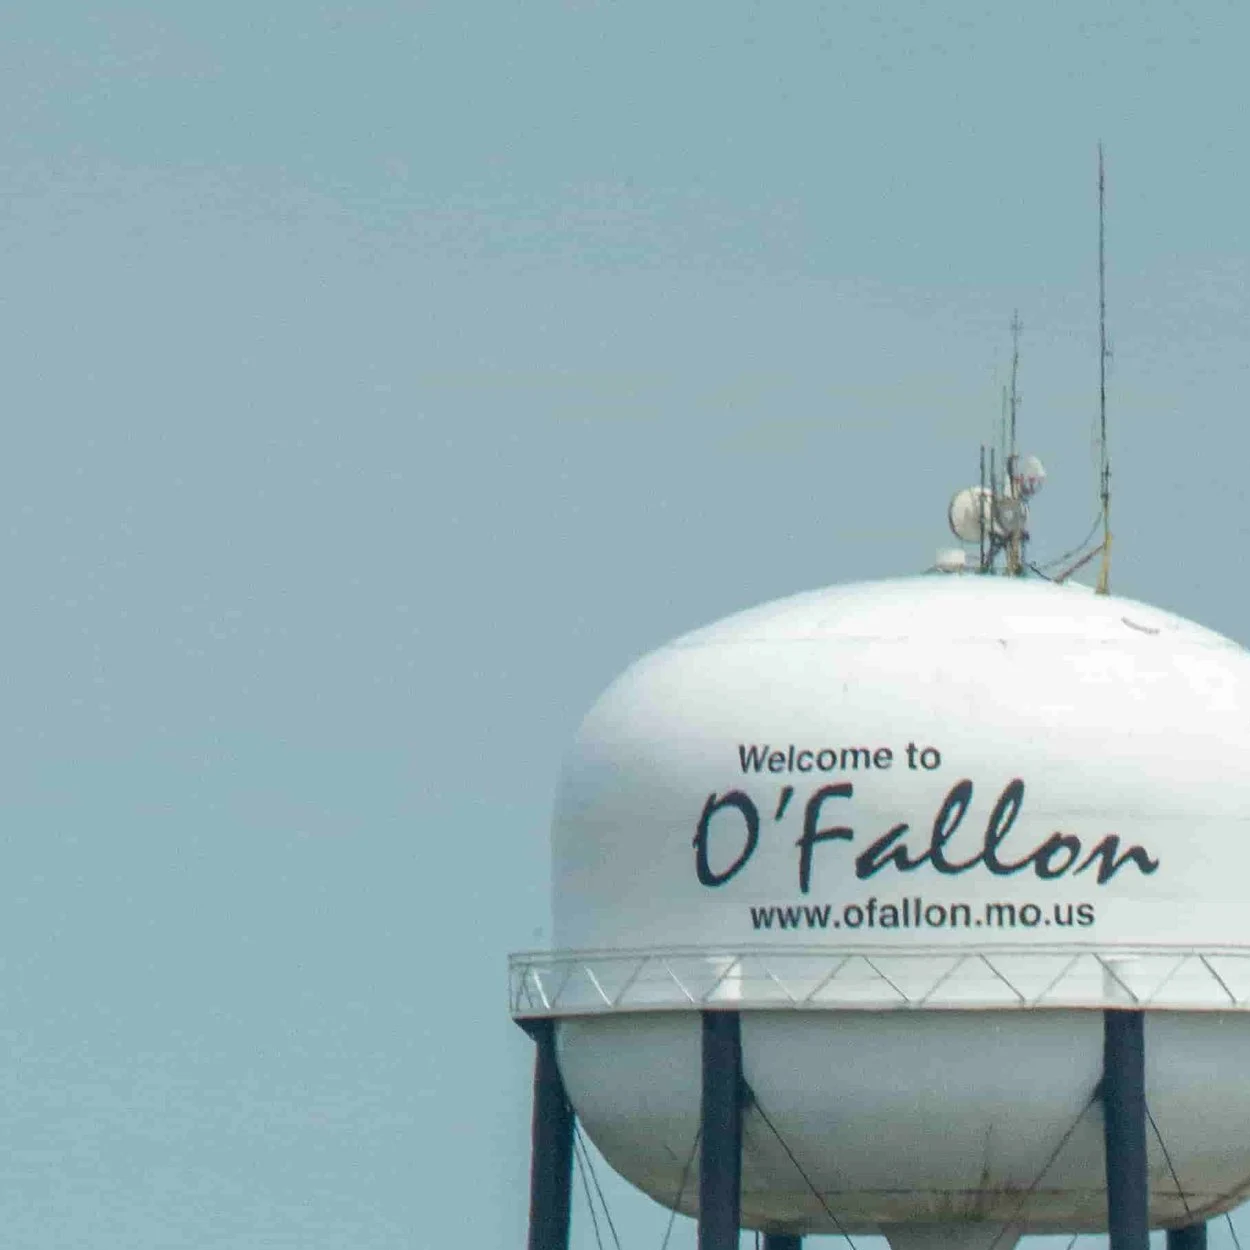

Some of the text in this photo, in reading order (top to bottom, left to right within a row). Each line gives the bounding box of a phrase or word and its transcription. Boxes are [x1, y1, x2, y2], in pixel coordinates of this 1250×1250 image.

[738, 741, 941, 773] Welcome to
[692, 778, 1160, 894] O'Fallon
[751, 898, 1095, 930] www.ofallon.mo.us
